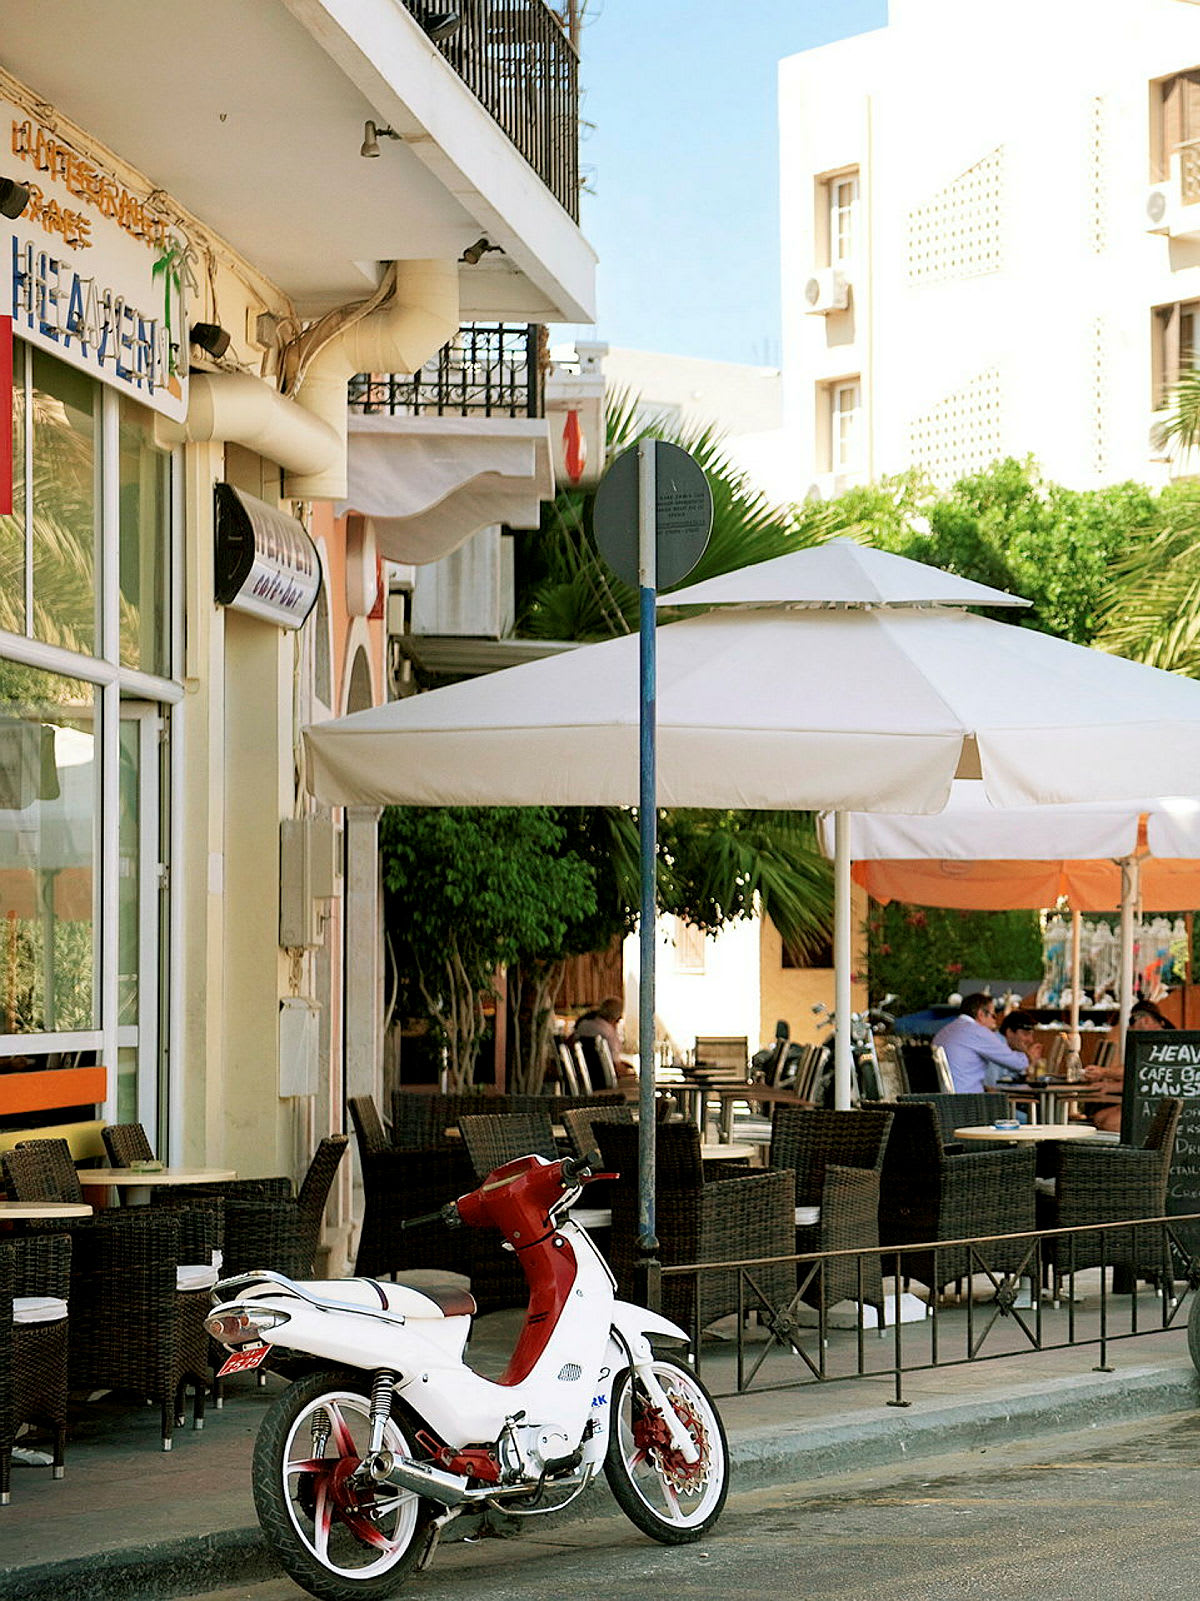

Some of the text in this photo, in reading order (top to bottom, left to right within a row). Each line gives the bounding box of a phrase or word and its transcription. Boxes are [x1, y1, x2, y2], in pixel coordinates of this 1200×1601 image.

[12, 235, 166, 396] HEAVEN
[252, 512, 312, 577] HEAVEN
[1139, 1066, 1175, 1083] CAFE
